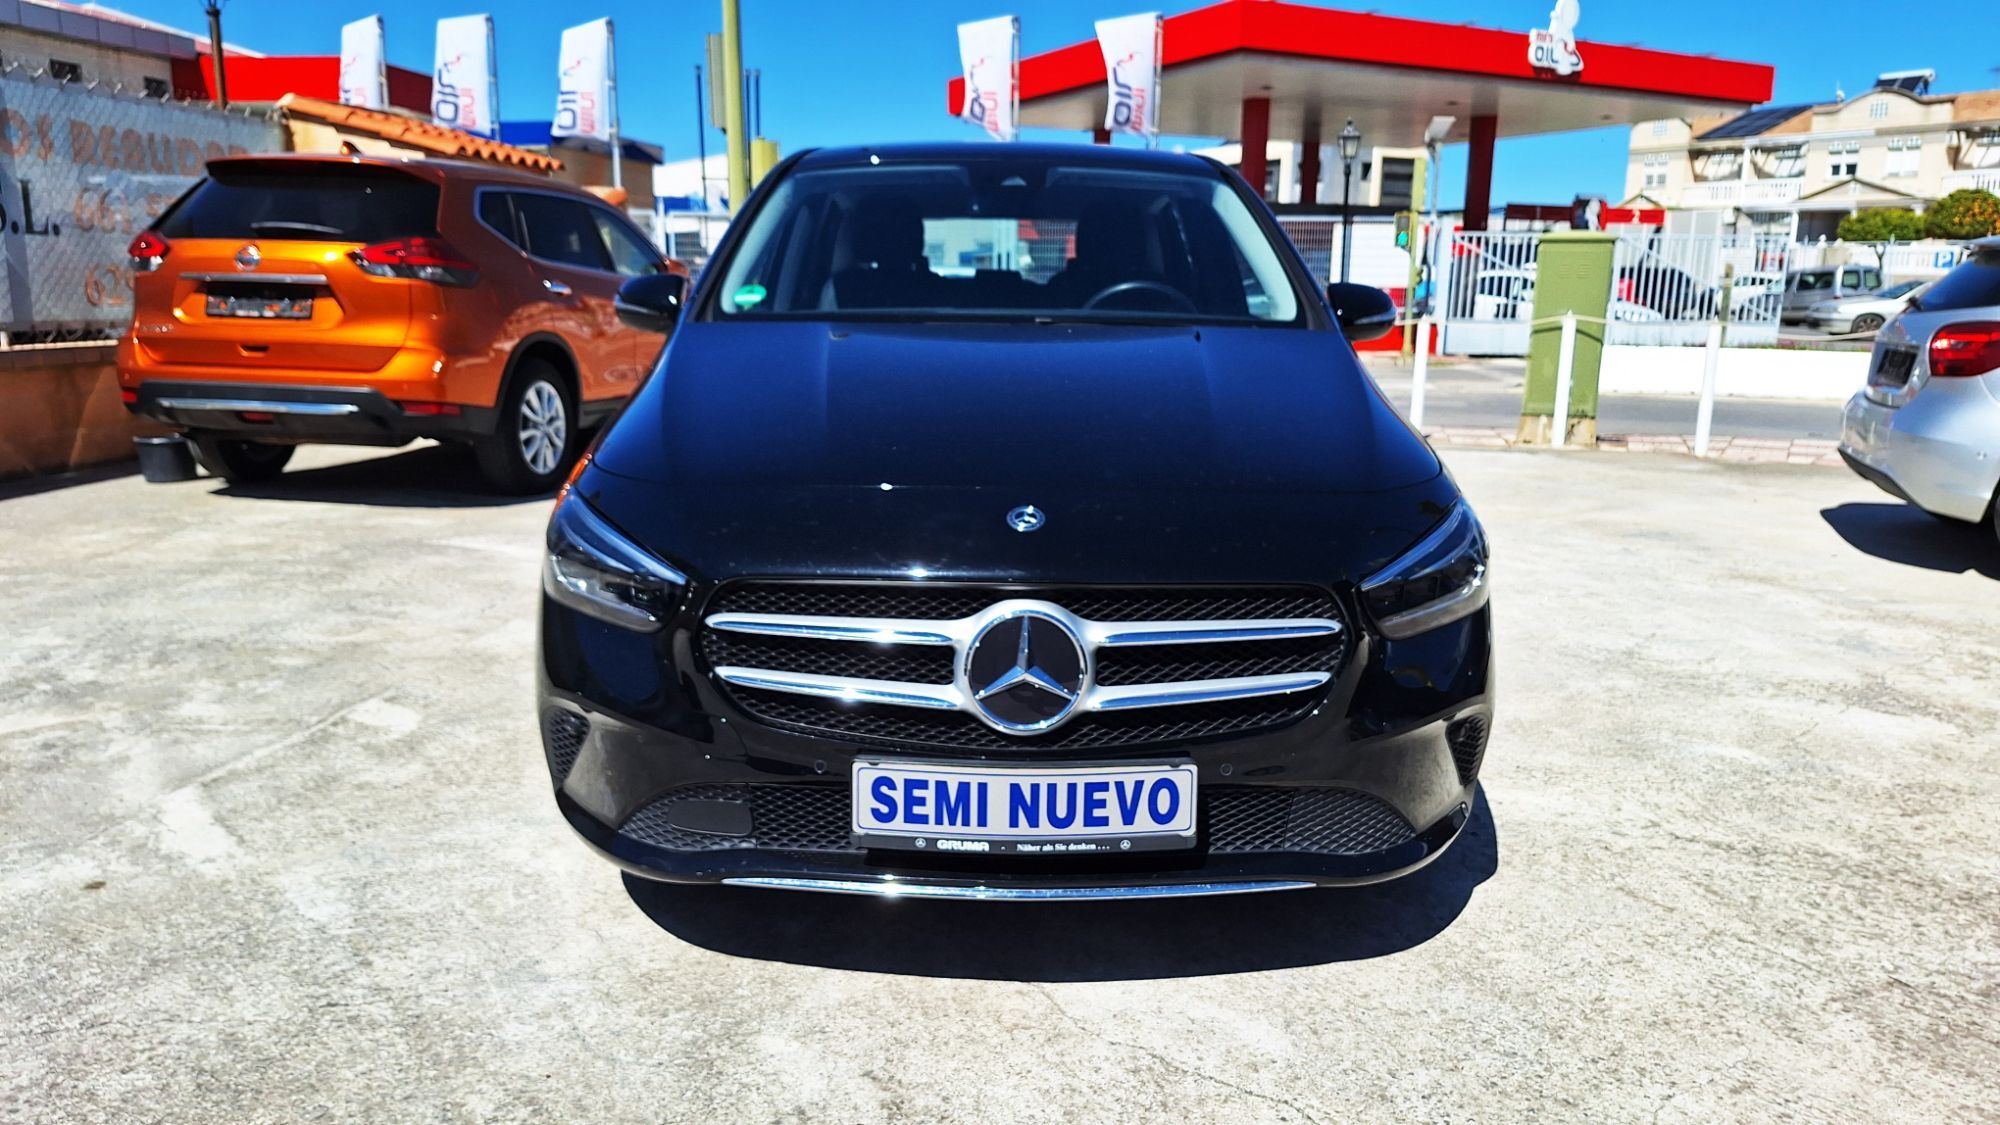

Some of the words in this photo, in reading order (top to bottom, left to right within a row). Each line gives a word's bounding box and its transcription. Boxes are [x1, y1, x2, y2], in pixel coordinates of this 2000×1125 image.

[1534, 46, 1559, 63] OIL
[870, 776, 989, 828] SEMI
[1008, 777, 1180, 829] NUEVO
[937, 839, 990, 852] GRUMA
